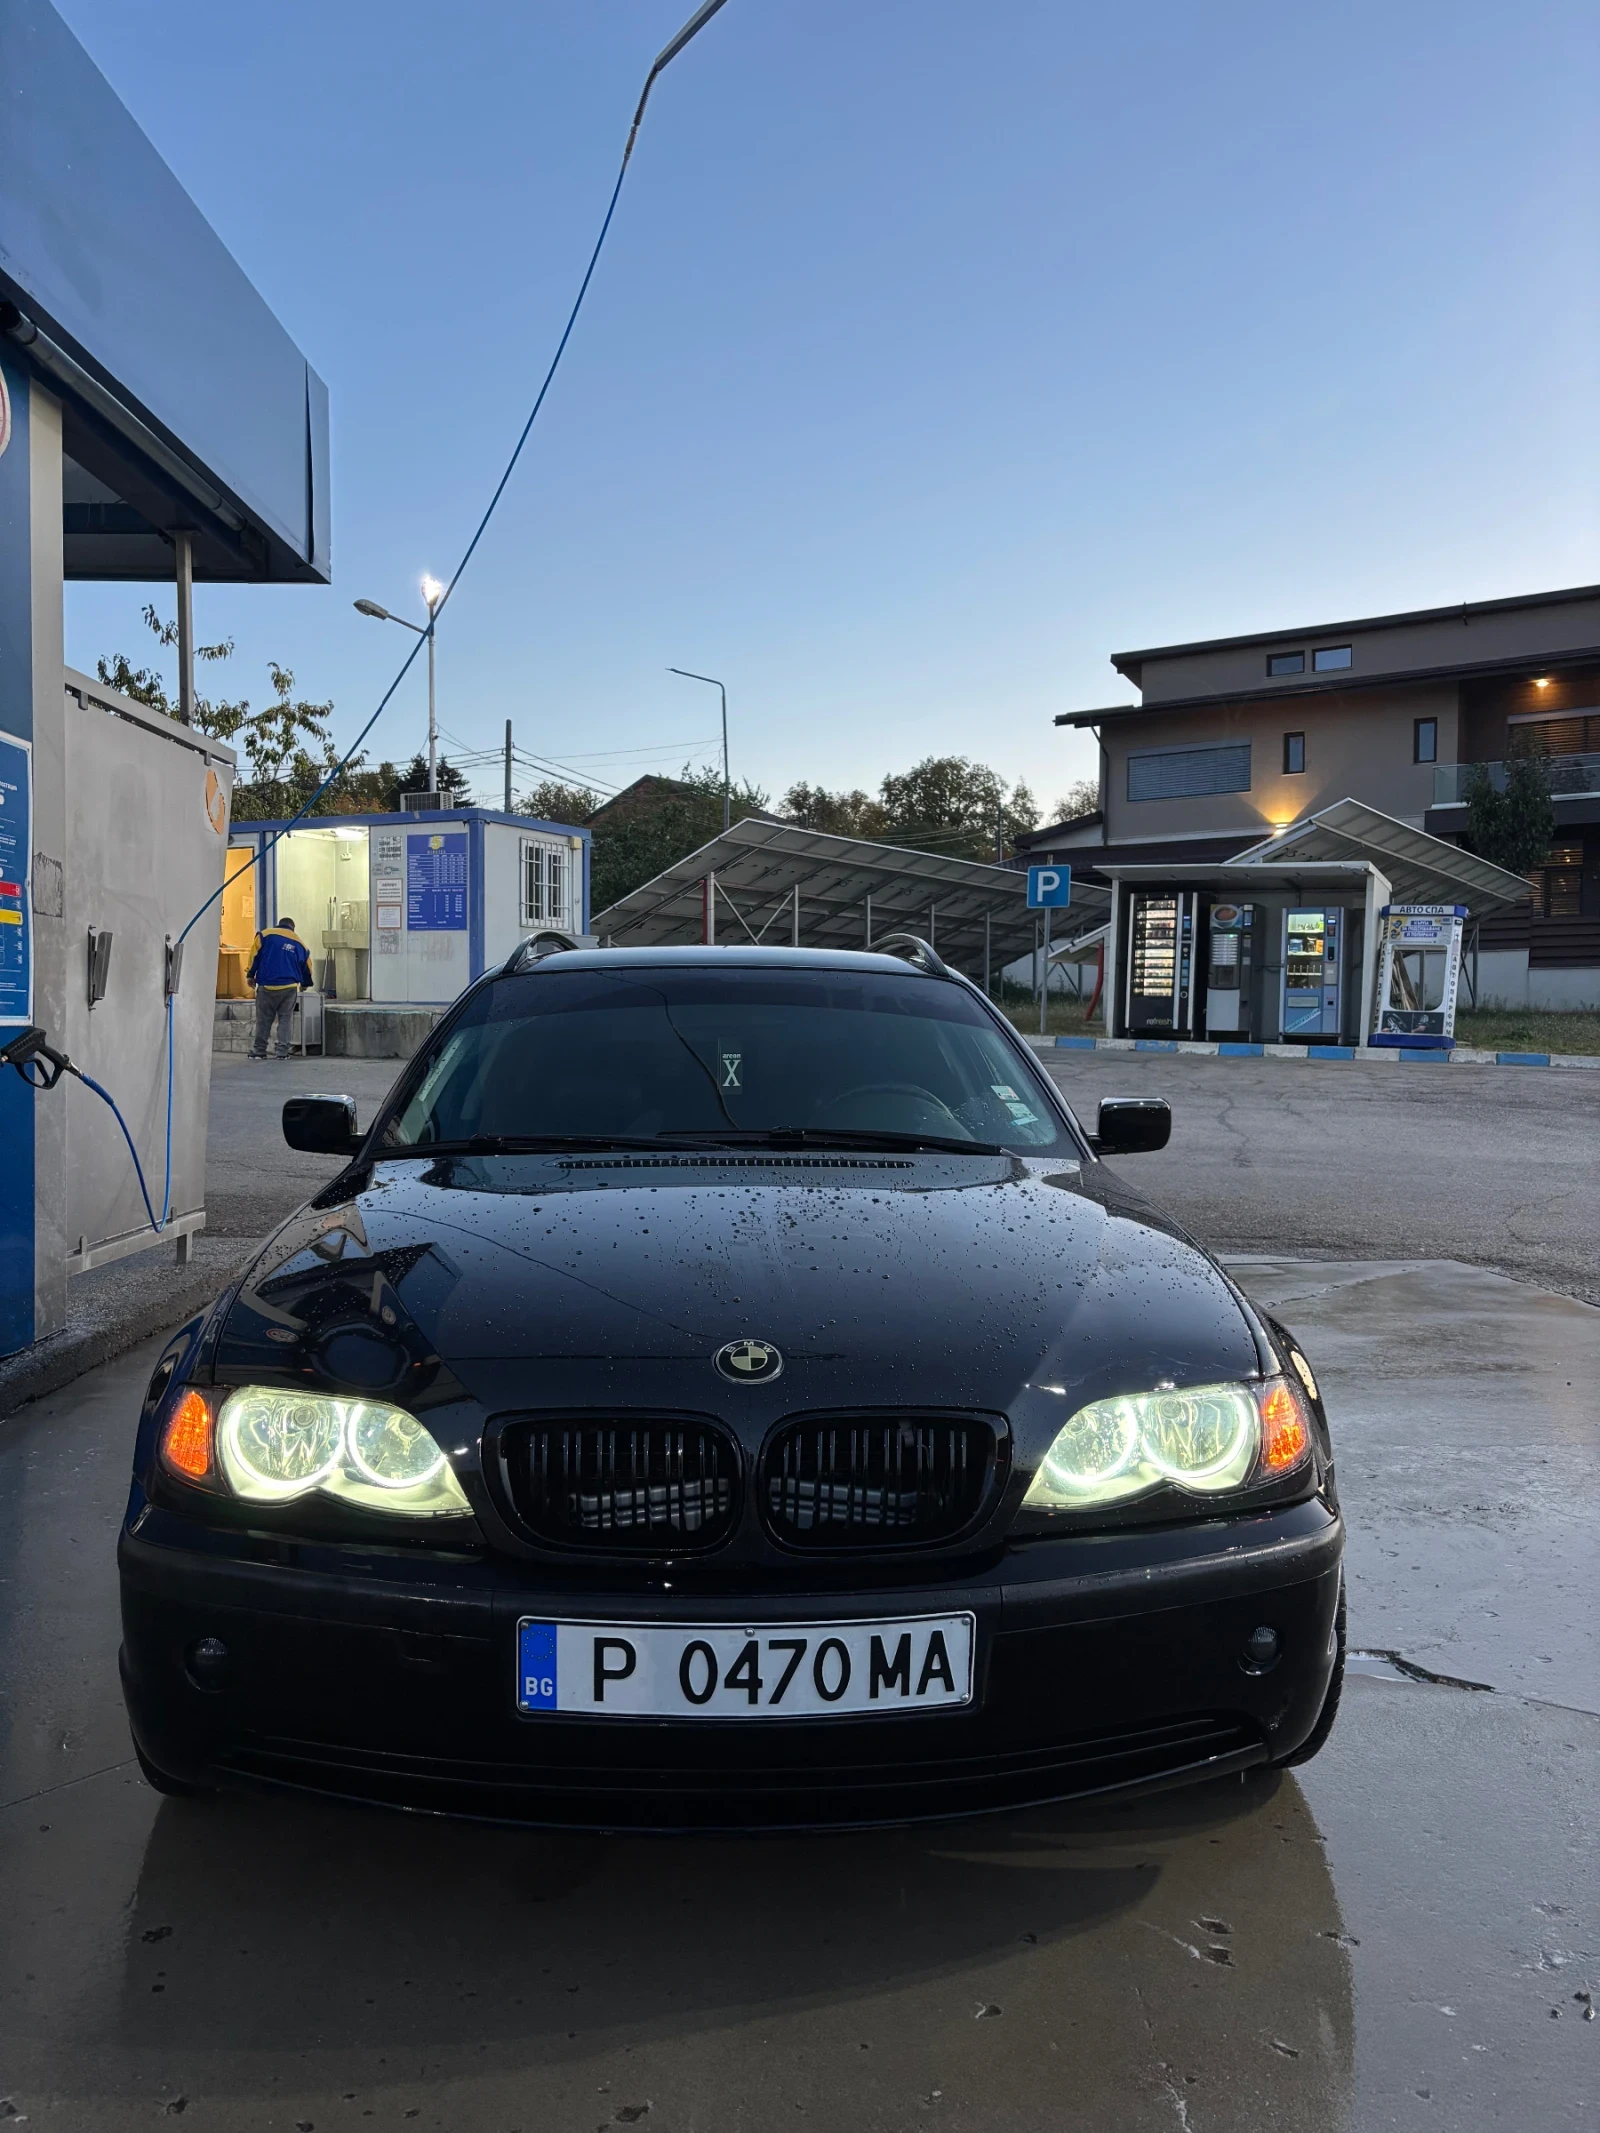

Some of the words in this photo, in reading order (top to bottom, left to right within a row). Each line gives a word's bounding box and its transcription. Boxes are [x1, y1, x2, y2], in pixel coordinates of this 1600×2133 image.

[1036, 871, 1060, 902] P
[722, 1060, 741, 1086] X
[594, 1637, 636, 1701] P
[679, 1637, 852, 1704] 0470
[869, 1630, 956, 1698] MA
[524, 1677, 553, 1696] BG
